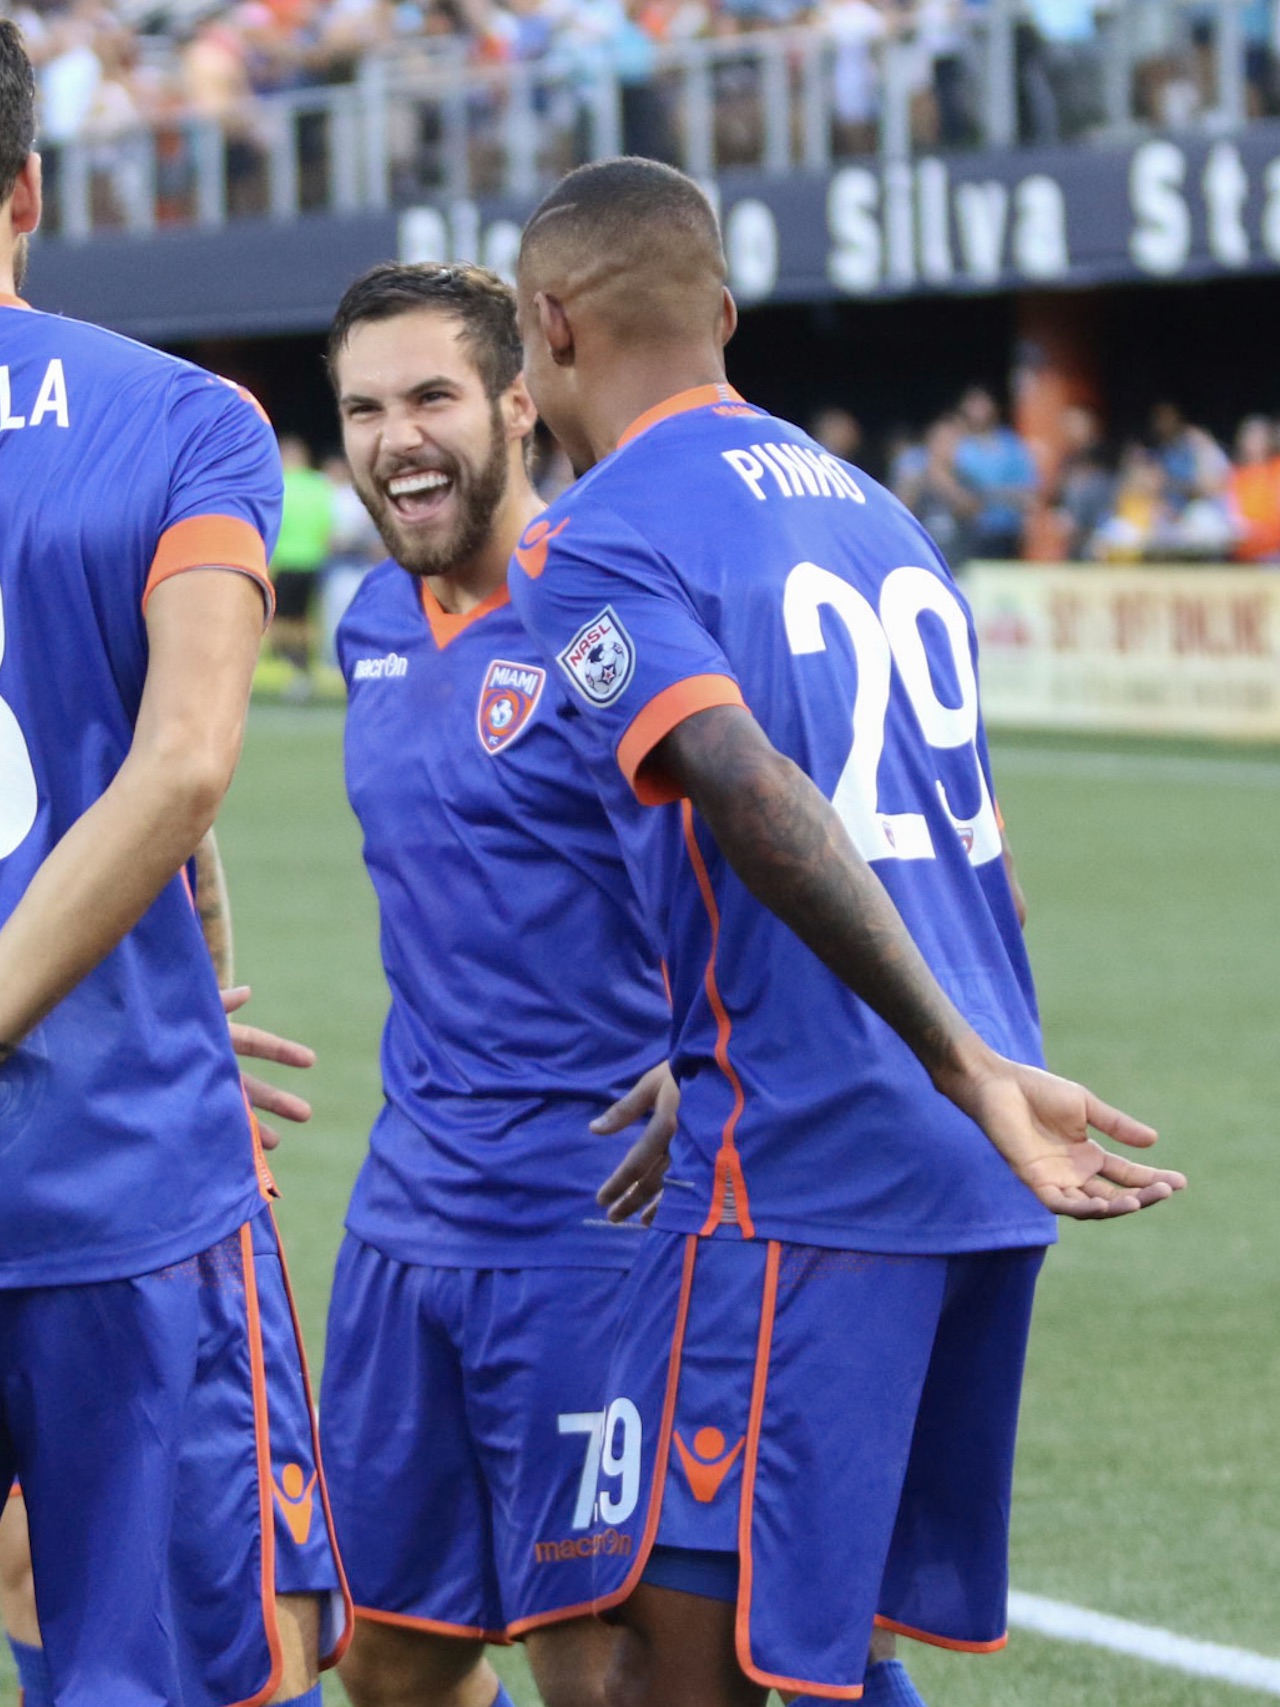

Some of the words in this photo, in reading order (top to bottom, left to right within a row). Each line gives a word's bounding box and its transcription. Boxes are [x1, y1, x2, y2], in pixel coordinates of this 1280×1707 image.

[826, 154, 1071, 294] Silva
[489, 665, 539, 696] MIAMI
[569, 623, 612, 668] NASL
[782, 561, 1003, 867] 29
